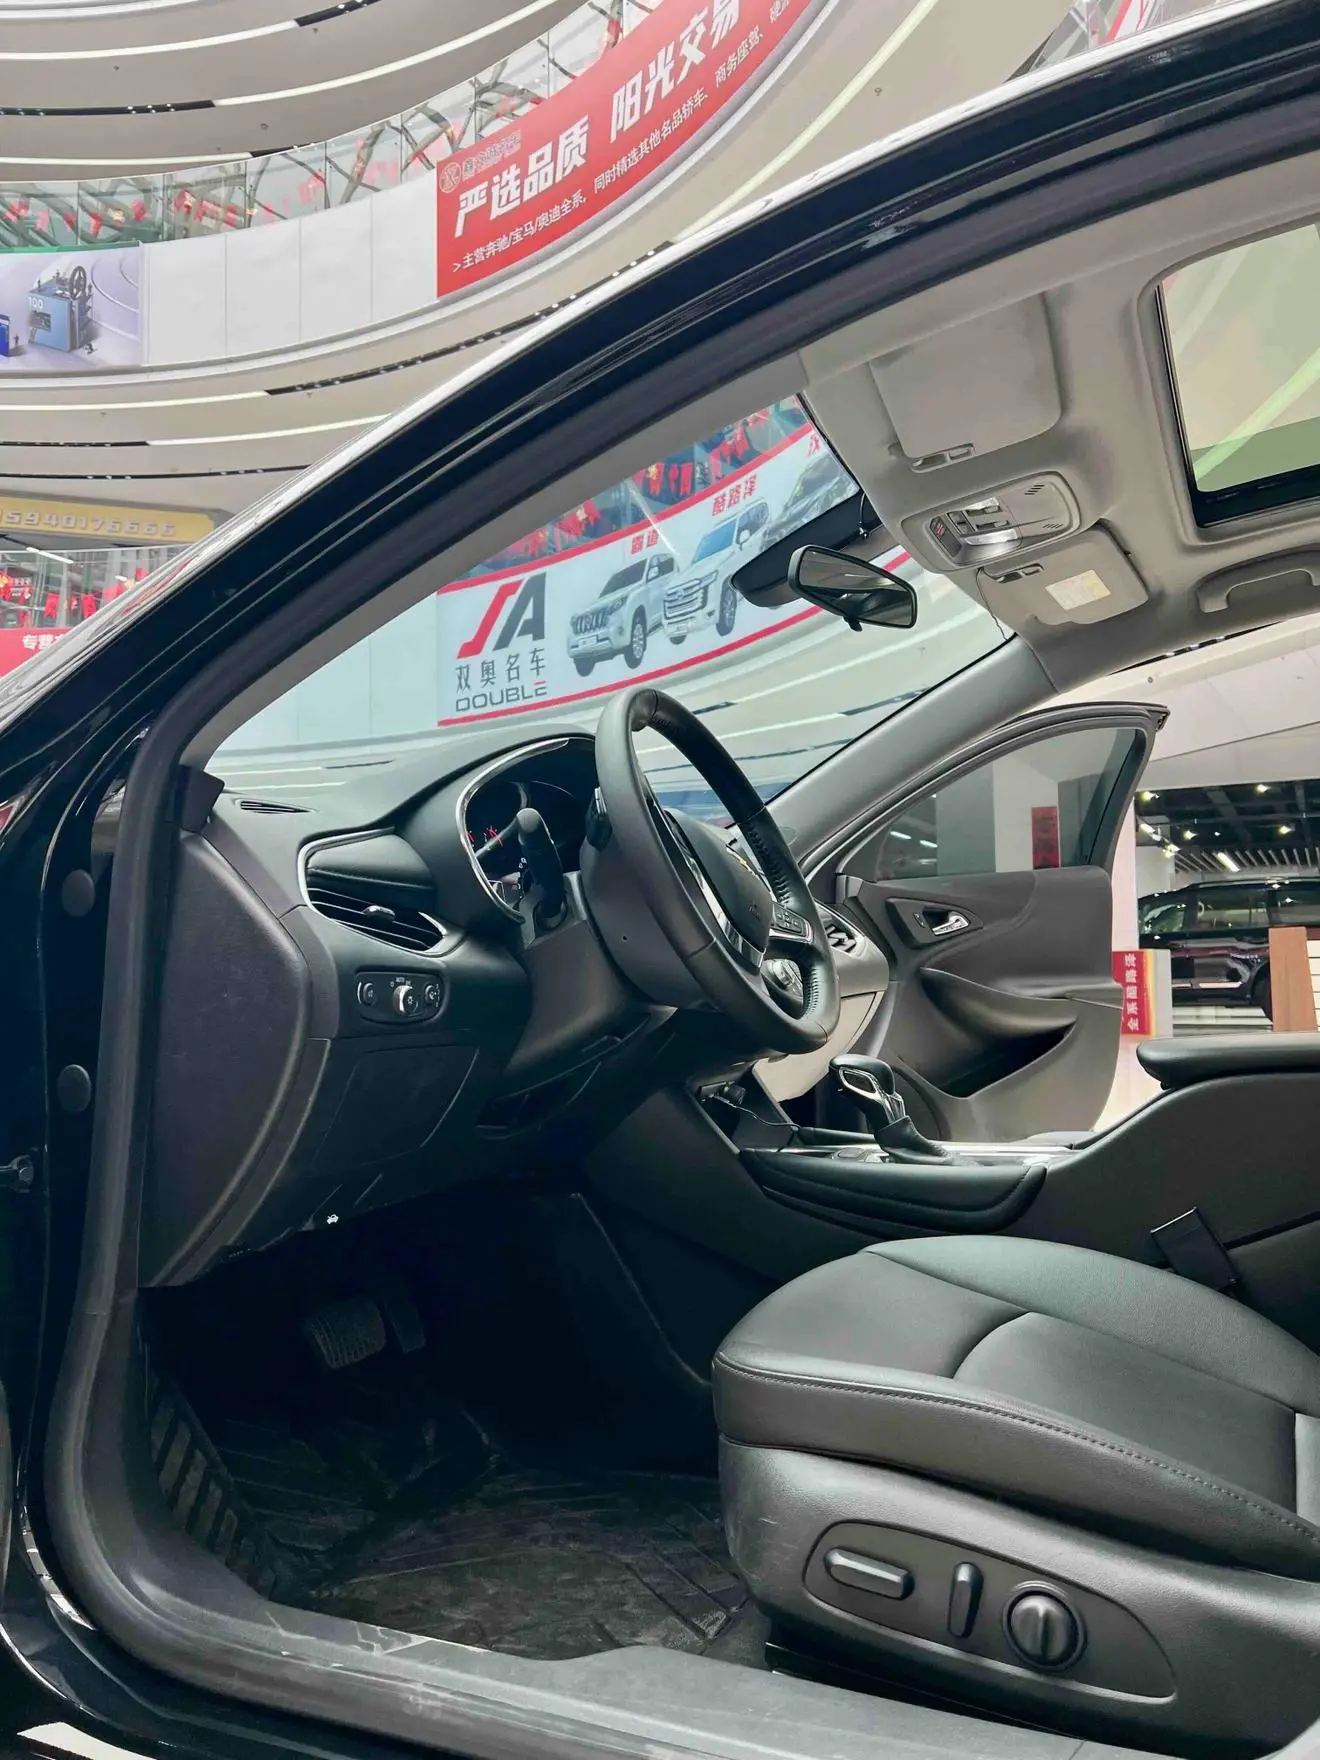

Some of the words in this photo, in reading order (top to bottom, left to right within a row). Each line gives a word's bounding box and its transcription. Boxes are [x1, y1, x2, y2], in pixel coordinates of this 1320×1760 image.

[454, 114, 589, 239] 严选品质
[609, 0, 740, 144] 阳光交易
[0, 509, 176, 536] 5940176666
[455, 647, 546, 693] 双奥名车
[455, 680, 548, 713] DOUBLE
